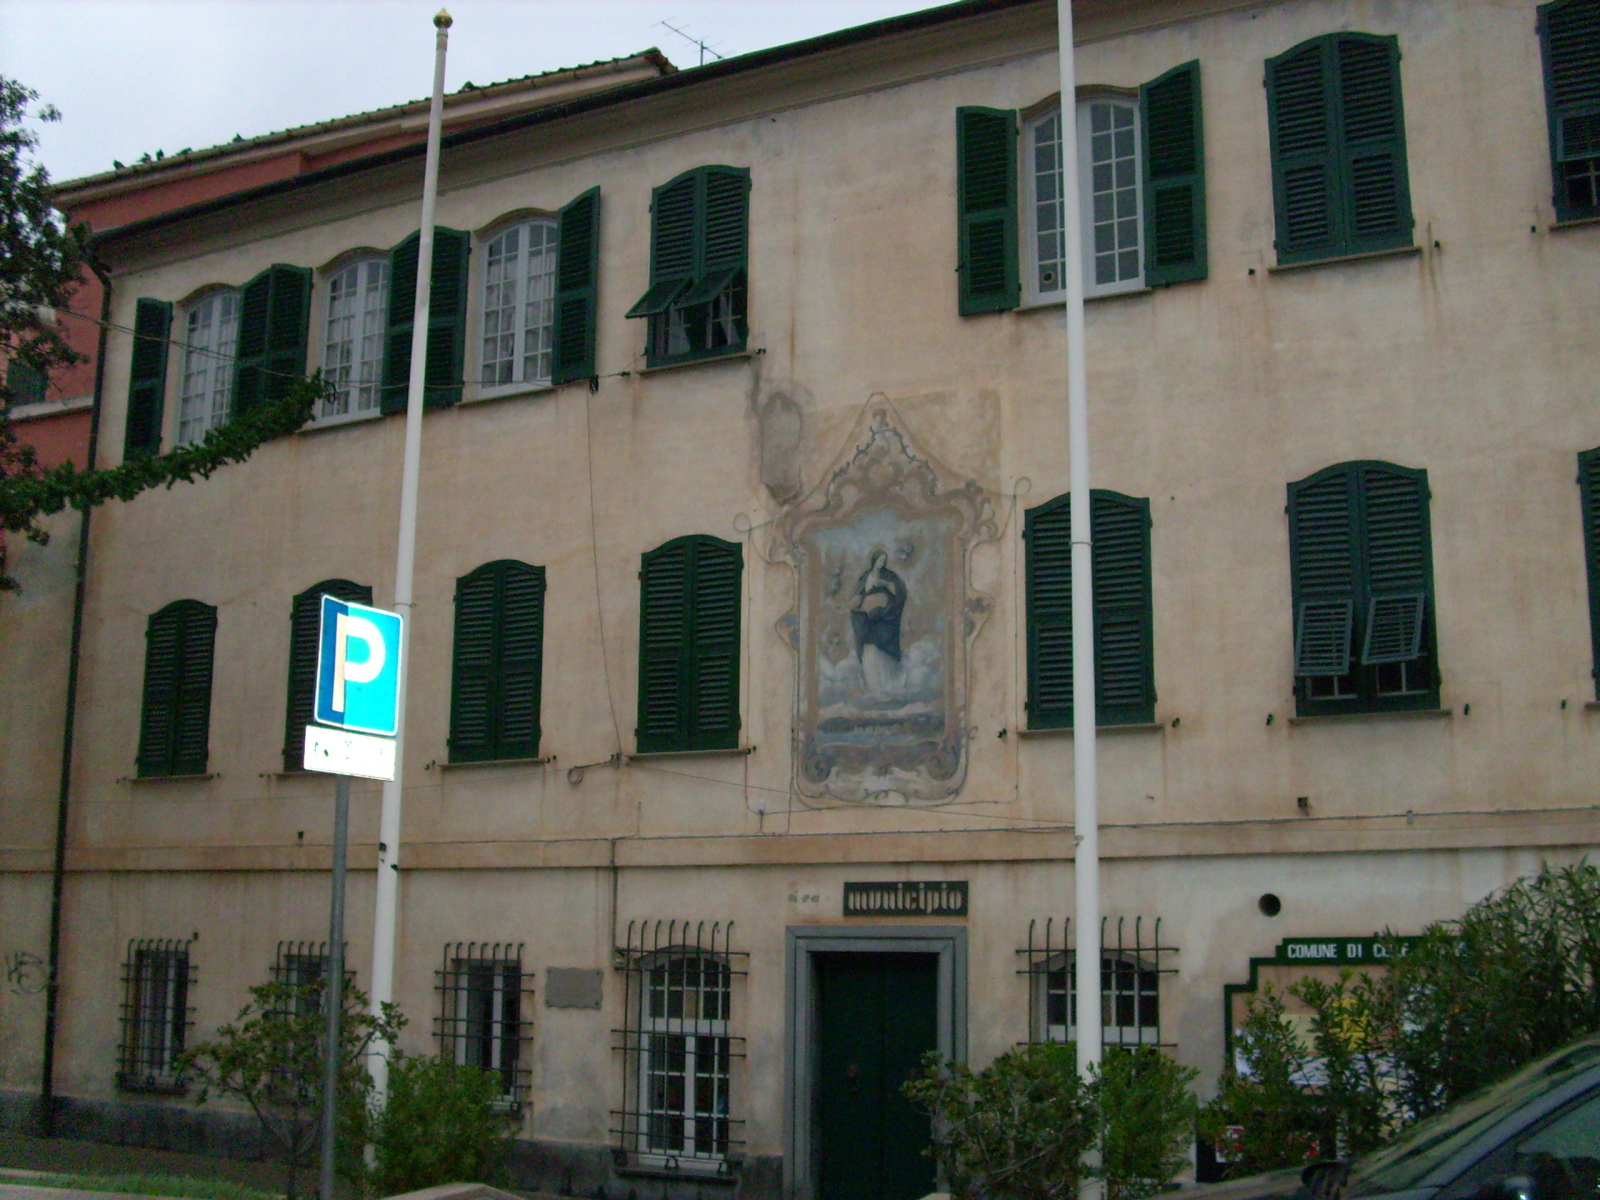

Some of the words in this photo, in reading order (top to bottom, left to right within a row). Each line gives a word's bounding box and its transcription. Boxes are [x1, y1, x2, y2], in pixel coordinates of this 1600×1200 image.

[332, 612, 385, 712] P
[848, 882, 962, 914] municipio
[1287, 943, 1338, 958] COMUNE
[1347, 943, 1362, 958] DI
